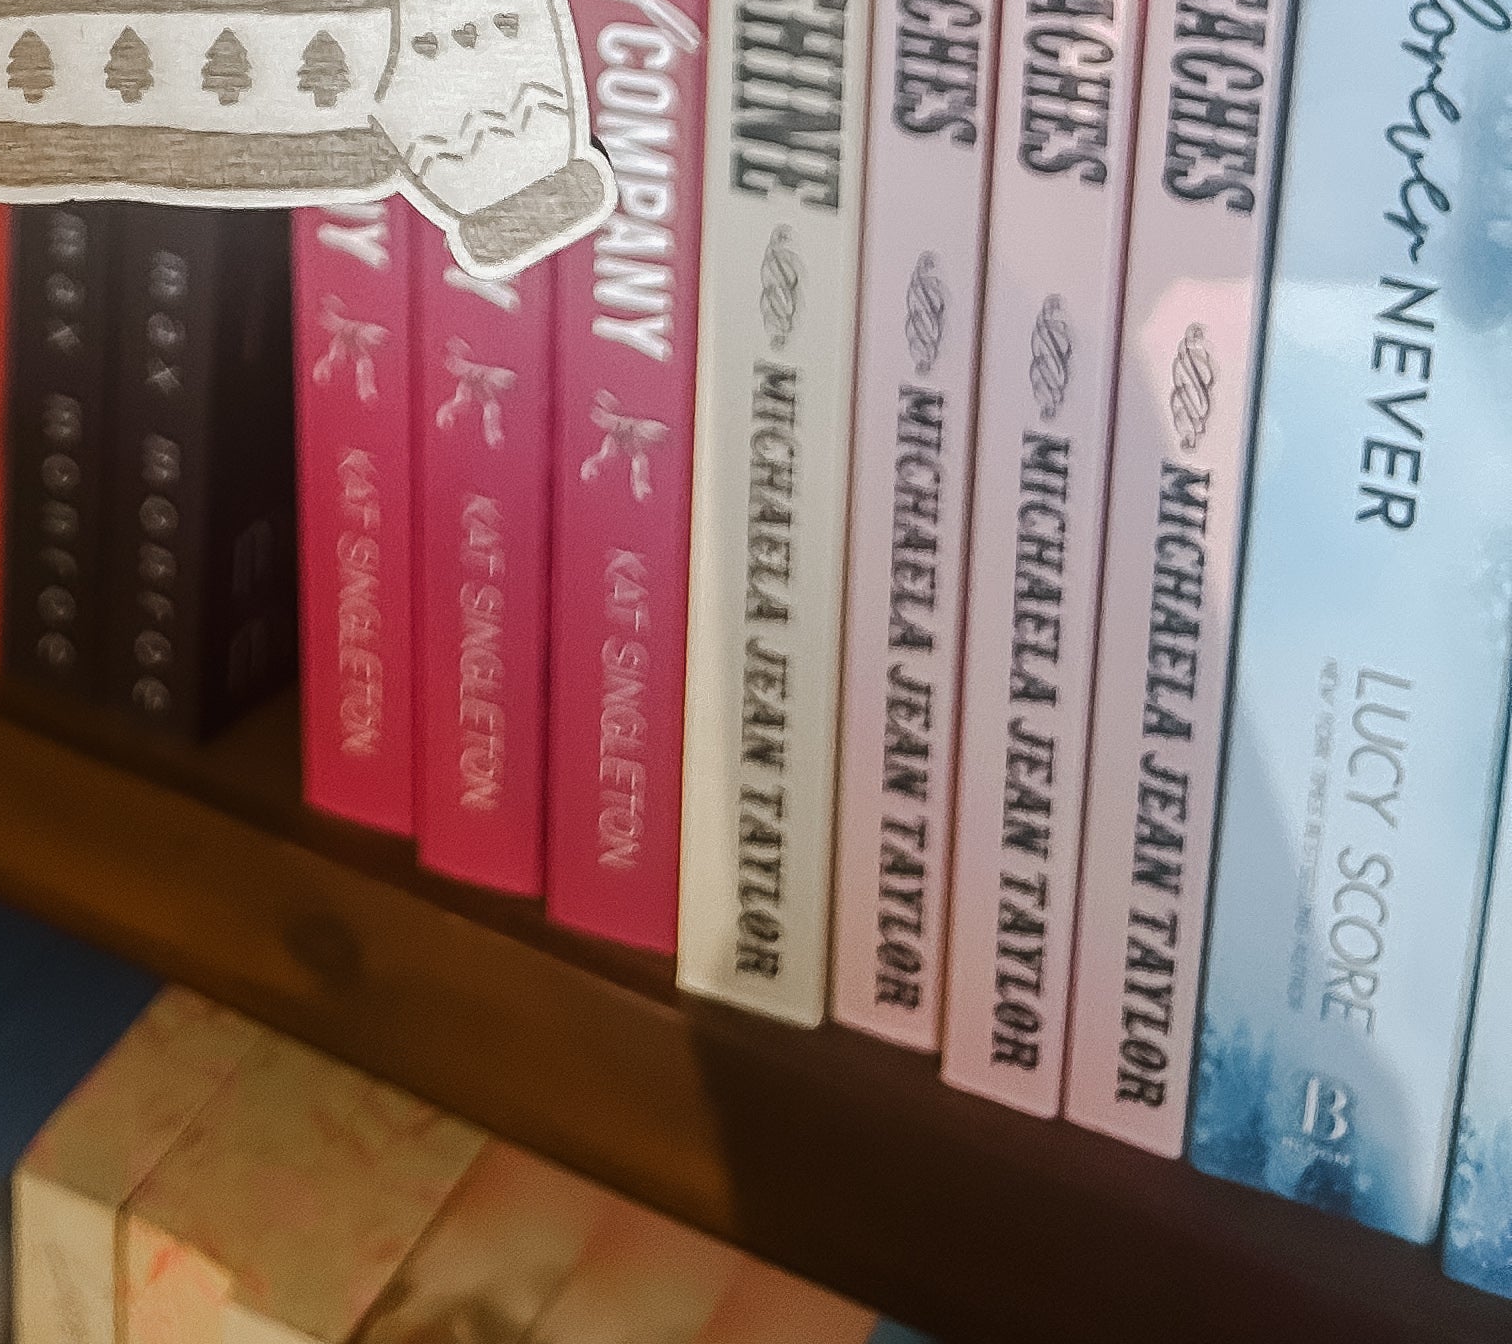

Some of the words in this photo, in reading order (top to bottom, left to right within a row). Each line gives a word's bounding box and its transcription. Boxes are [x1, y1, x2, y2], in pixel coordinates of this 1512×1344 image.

[590, 23, 677, 361] COMPANY
[744, 360, 799, 624] MICHAELA
[1355, 275, 1439, 531] NEVER
[461, 493, 505, 576] KAT
[605, 547, 654, 629] KAT
[886, 384, 946, 652] MICHAELA
[1008, 429, 1071, 707] MICHAELA
[1144, 459, 1212, 741] MICHAELA
[336, 534, 384, 756] SINGLETON
[456, 583, 508, 812] SINGLETON
[740, 637, 788, 771] JEAN
[882, 664, 934, 804] JEAN
[596, 638, 650, 871] SINGLETON
[1001, 716, 1056, 856] JEAN
[1132, 750, 1190, 893] JEAN
[1344, 667, 1412, 831] LUCY
[735, 784, 787, 981] TAYLOR
[874, 815, 929, 1012] TAYLOR
[991, 869, 1049, 1071] TAYLOR
[1320, 845, 1394, 1037] SCORE
[1116, 904, 1179, 1108] TAYLOR
